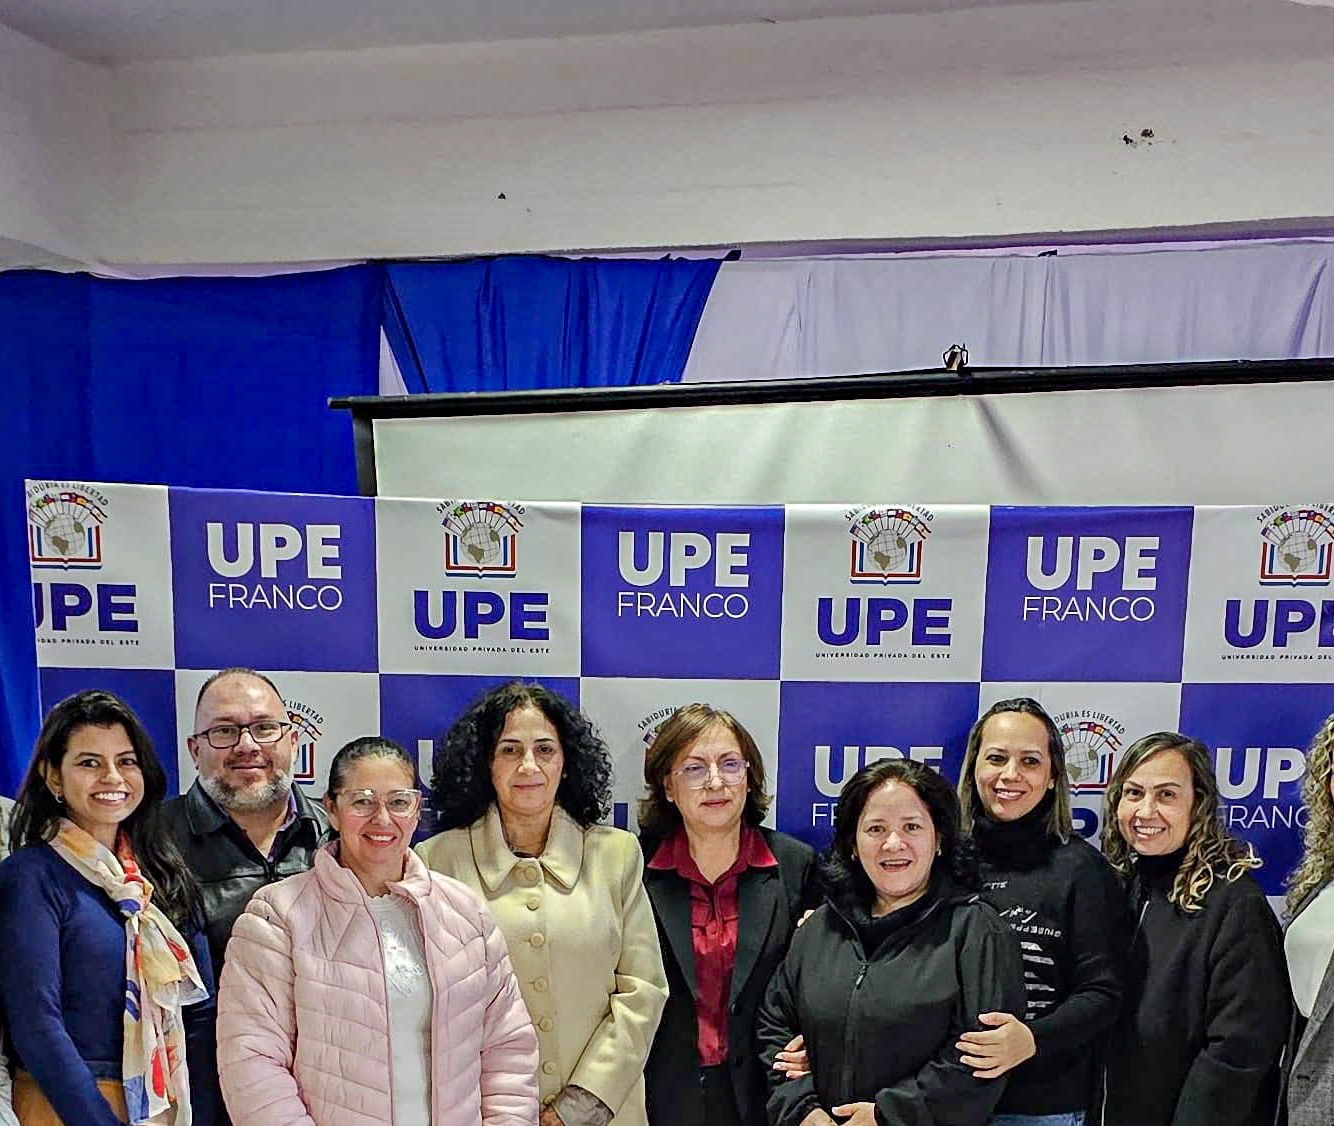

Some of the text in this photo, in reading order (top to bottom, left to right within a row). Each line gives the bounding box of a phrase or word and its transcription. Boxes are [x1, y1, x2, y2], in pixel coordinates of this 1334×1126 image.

[206, 522, 343, 580] UPE
[618, 531, 750, 588] UPE
[1026, 536, 1160, 591] UPE
[209, 582, 343, 611] FRANCO
[413, 590, 550, 641] UPE
[617, 591, 749, 619] FRANCO
[1022, 596, 1155, 622] FRANCO
[817, 597, 953, 647] UPE
[289, 700, 324, 724] LIBERTAD
[1054, 709, 1125, 735] DURIA ES LIBERTAD
[1215, 747, 1307, 800] UP
